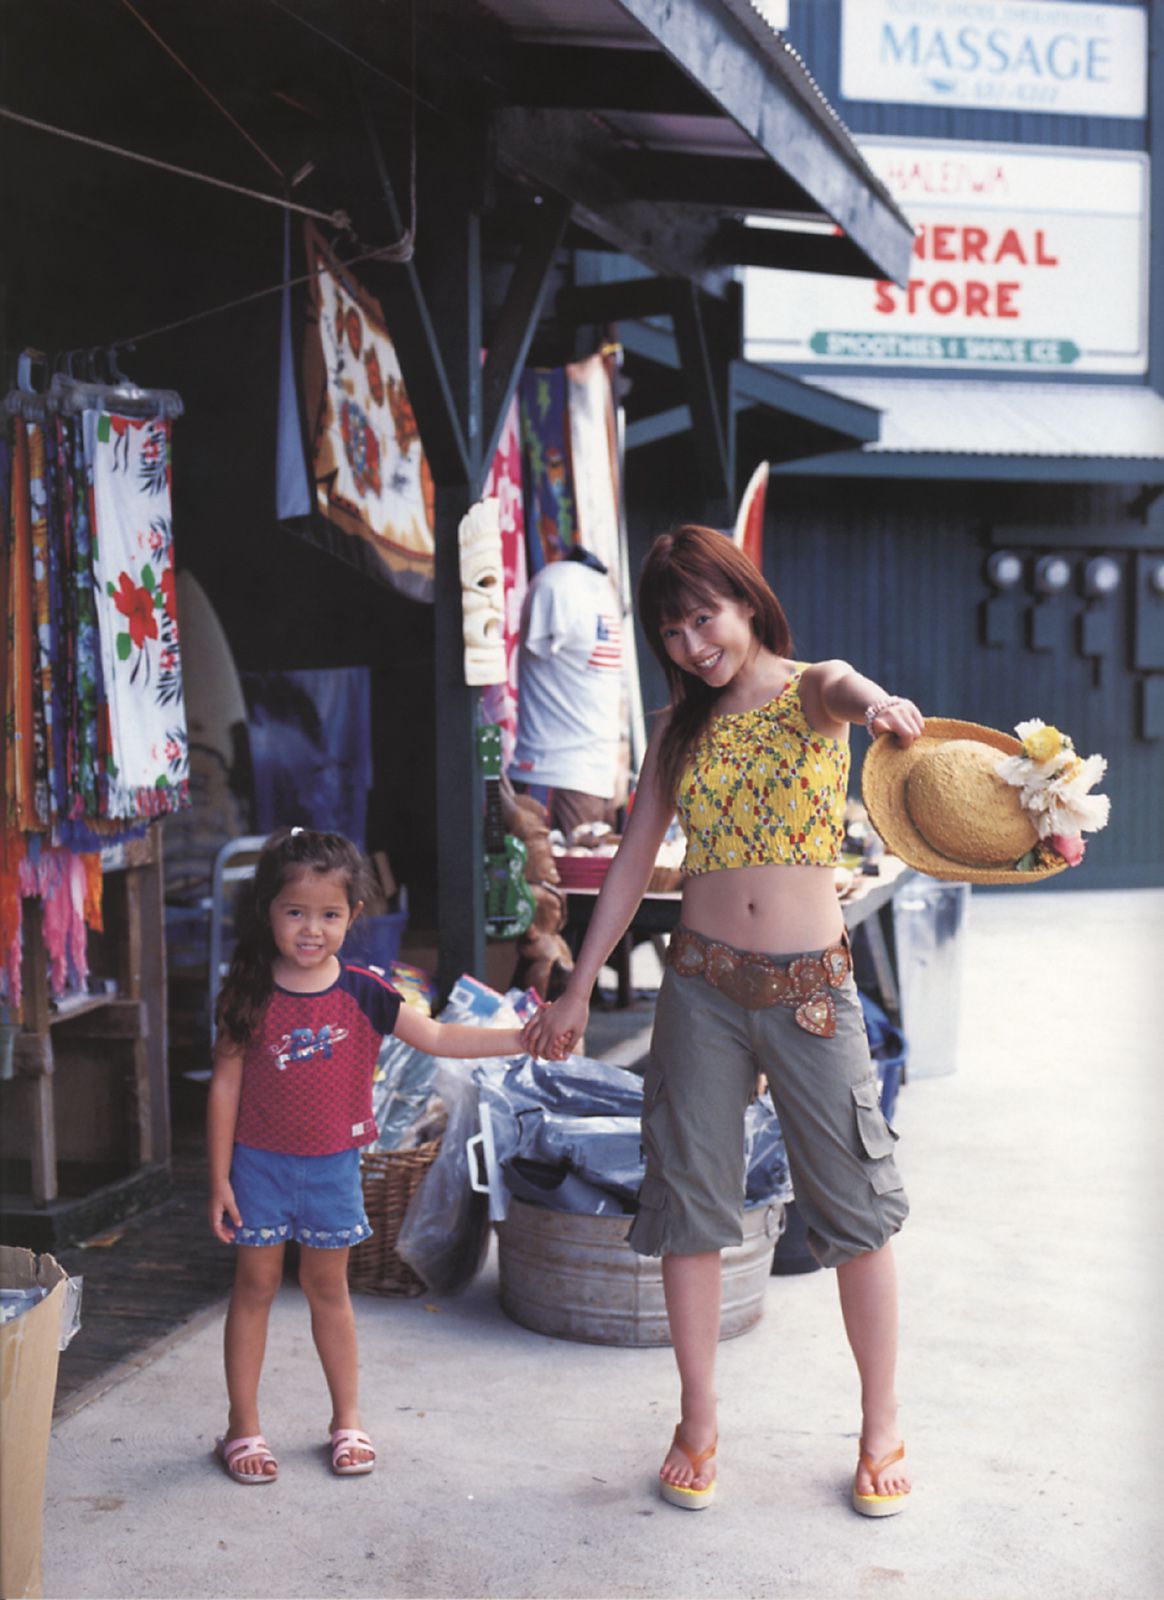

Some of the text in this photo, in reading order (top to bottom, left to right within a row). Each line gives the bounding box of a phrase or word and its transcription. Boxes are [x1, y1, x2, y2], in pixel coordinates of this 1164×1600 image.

[881, 21, 1112, 82] MASSAGE
[912, 224, 1058, 267] NERAL
[874, 279, 1021, 318] STORE
